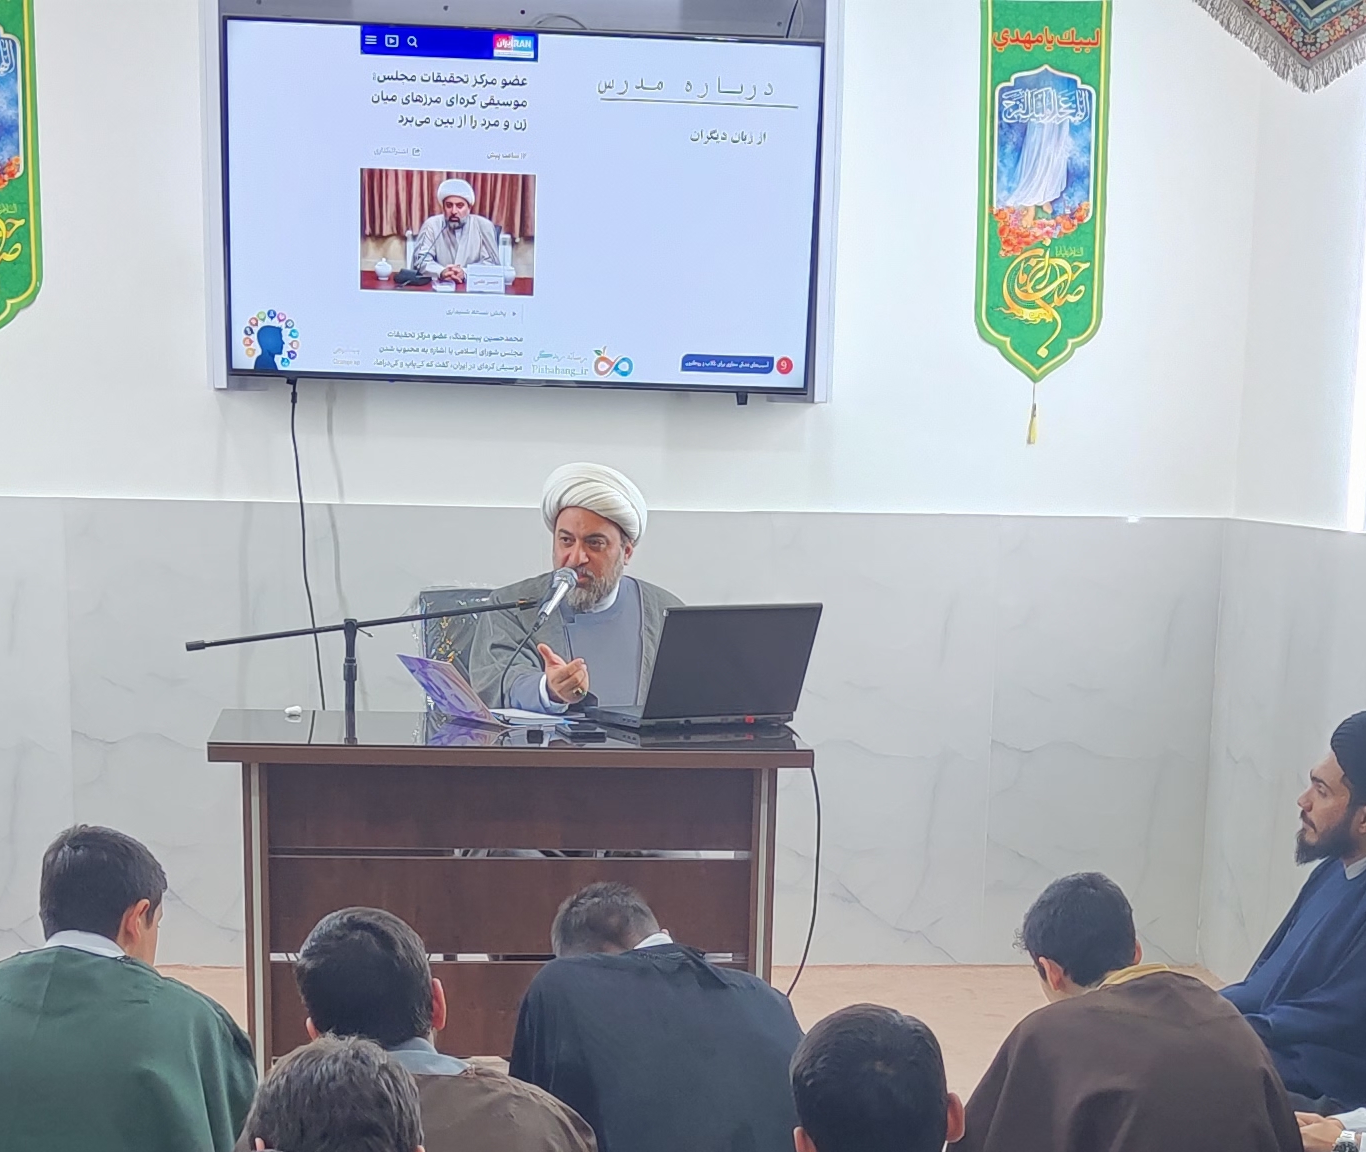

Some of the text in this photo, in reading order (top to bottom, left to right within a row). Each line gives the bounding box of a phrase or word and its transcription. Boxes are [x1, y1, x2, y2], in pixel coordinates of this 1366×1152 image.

[421, 72, 469, 86] تحقیقات
[472, 74, 497, 88] مرکز
[501, 74, 528, 89] عضو
[597, 76, 774, 101] درباره مدرس
[371, 90, 397, 104] میان
[401, 92, 441, 106] مرزهای
[480, 96, 528, 110] موسیقی
[434, 116, 455, 128] بین
[457, 114, 467, 128] از
[470, 115, 477, 129] را
[480, 118, 500, 130] مرد
[503, 119, 510, 130] و
[514, 118, 527, 131] زن
[689, 129, 767, 145] از زبان دیگران
